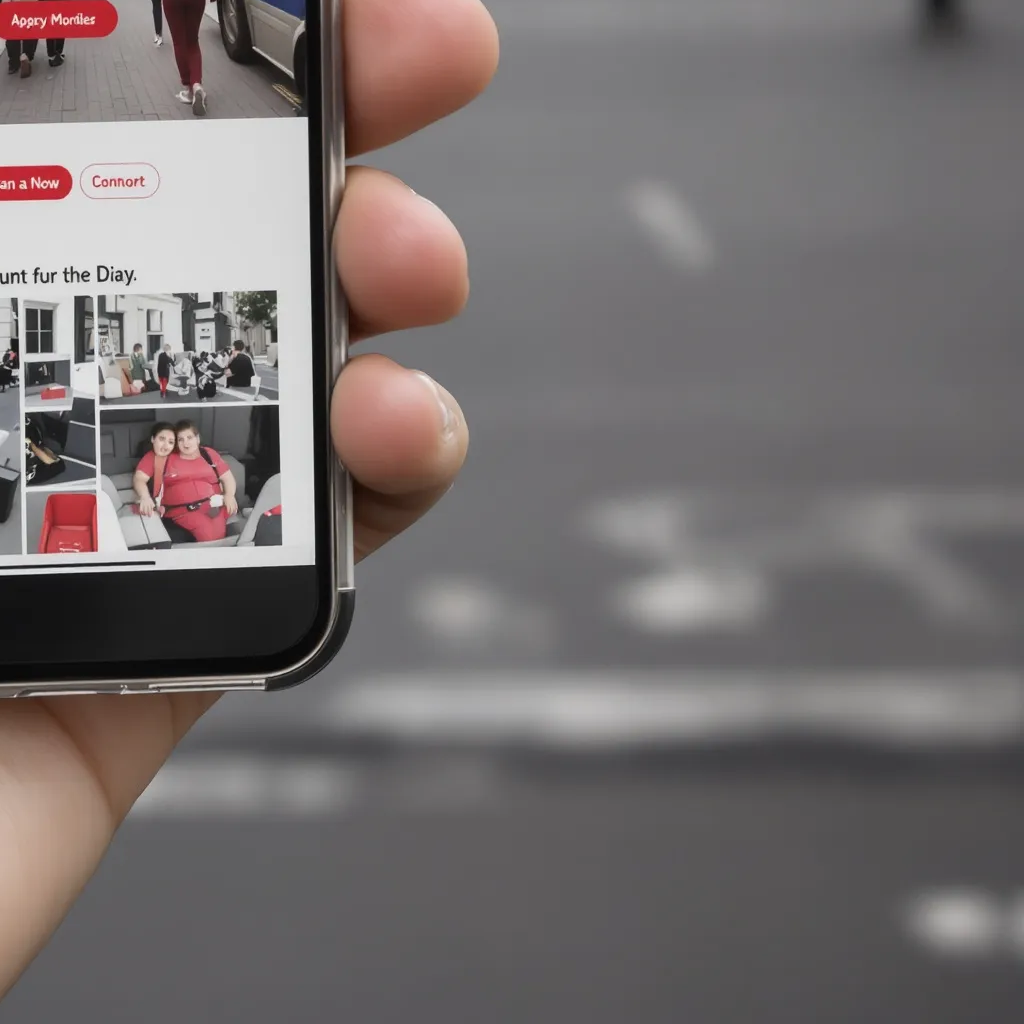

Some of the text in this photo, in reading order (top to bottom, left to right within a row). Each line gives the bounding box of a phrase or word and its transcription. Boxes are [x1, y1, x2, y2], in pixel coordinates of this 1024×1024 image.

[18, 179, 28, 190] a
[30, 176, 60, 190] Now
[32, 267, 58, 284] fur
[62, 266, 91, 283] the
